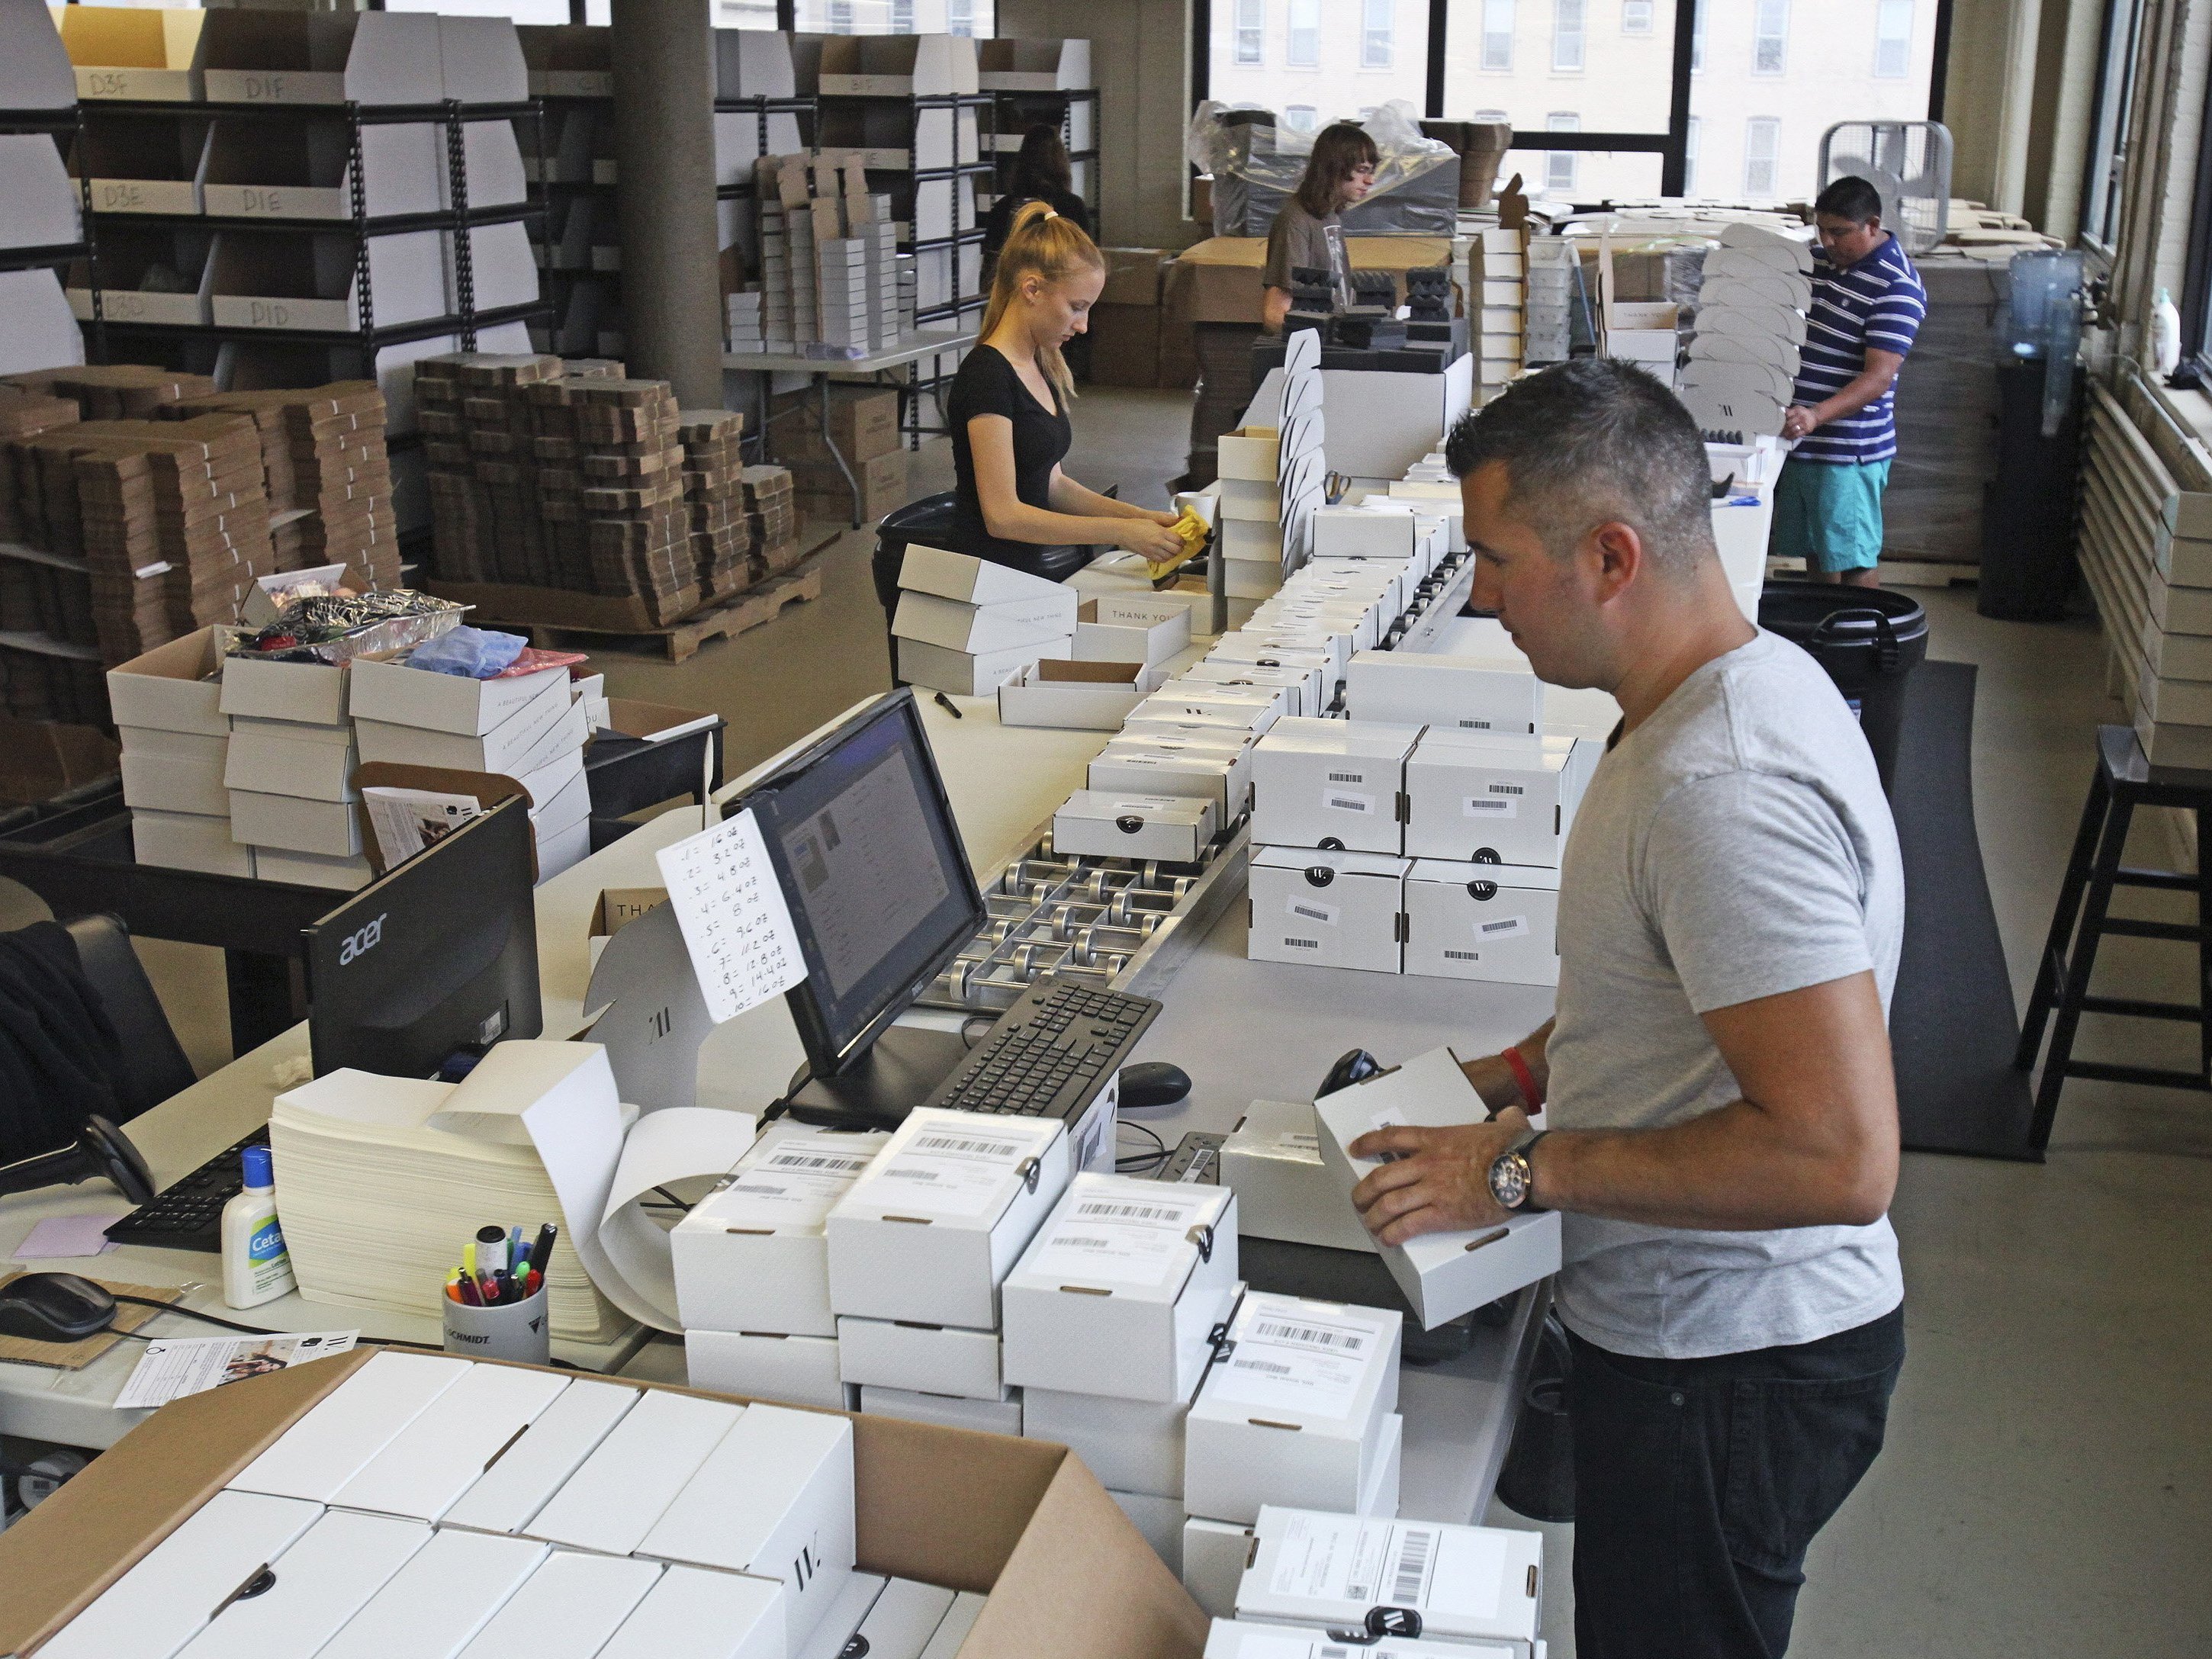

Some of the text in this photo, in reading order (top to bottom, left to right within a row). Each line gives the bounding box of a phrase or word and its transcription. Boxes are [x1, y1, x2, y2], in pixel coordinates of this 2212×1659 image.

[88, 72, 128, 97] D3F
[104, 185, 145, 208] D3E
[1112, 609, 1148, 620] THANK
[587, 714, 597, 724] OU
[732, 902, 742, 917] 8
[339, 913, 387, 966] acer
[252, 1233, 284, 1252] Ceta
